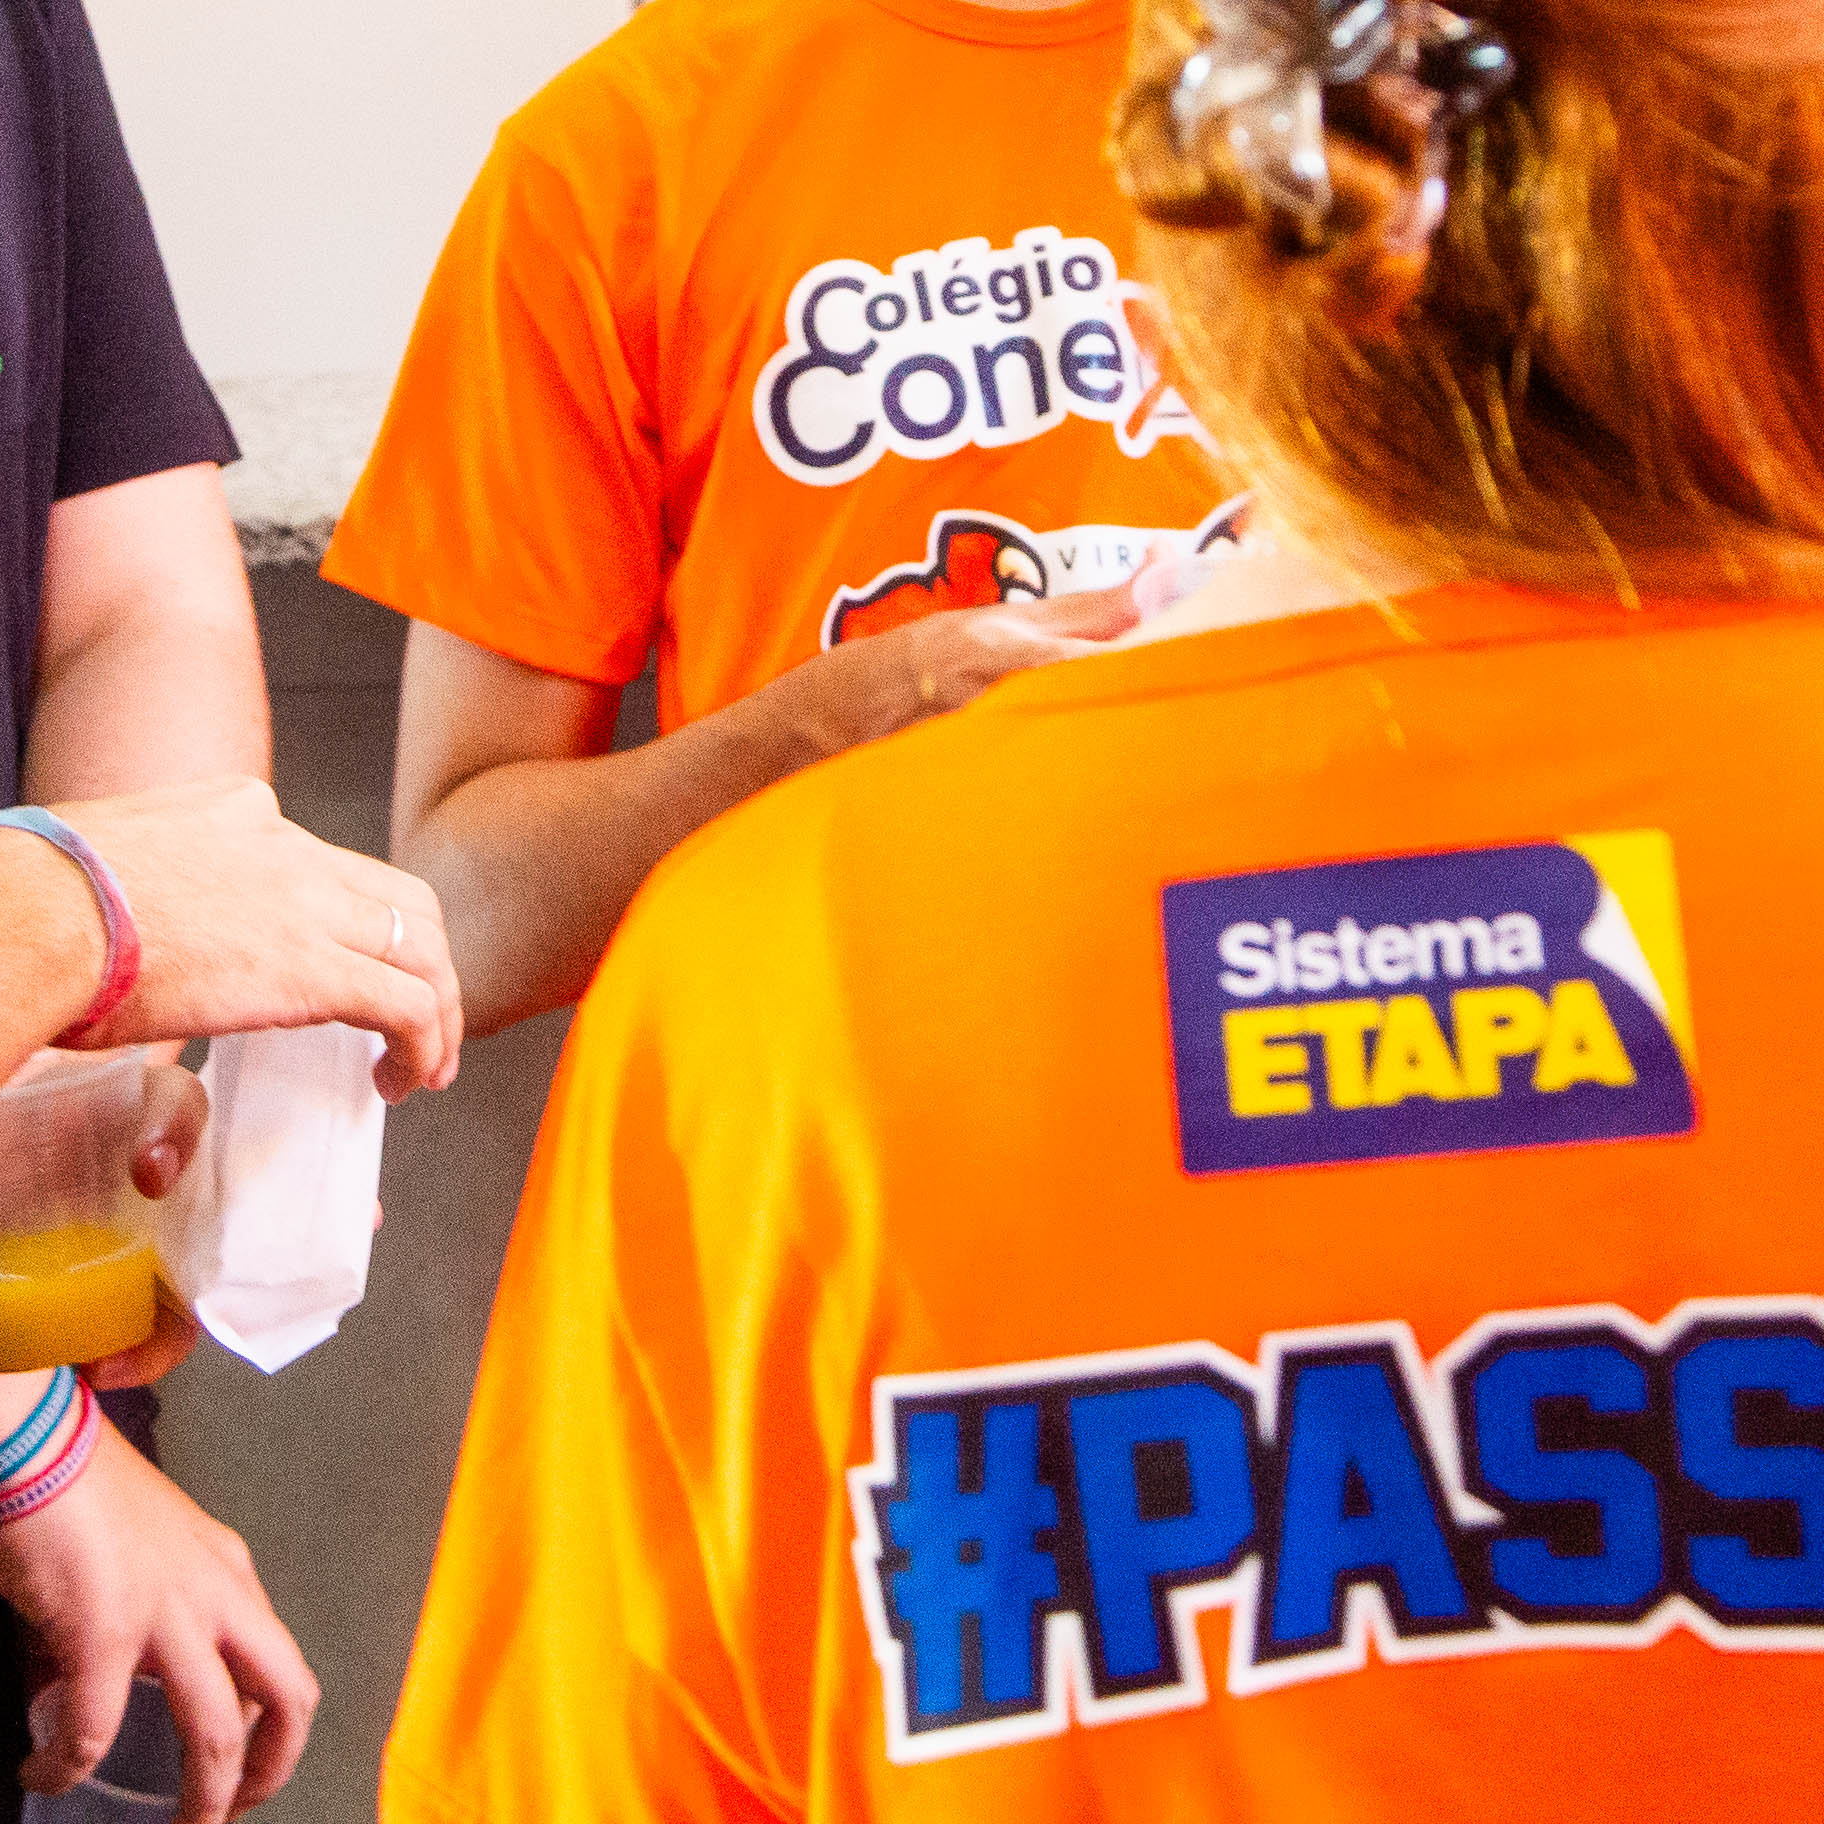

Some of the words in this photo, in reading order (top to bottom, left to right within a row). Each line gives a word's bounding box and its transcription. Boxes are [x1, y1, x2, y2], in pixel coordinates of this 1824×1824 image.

[801, 245, 1103, 375] Colégio
[1057, 546, 1134, 571] VIR
[1218, 909, 1545, 1000] Sistema
[1220, 976, 1637, 1120] ETAPA
